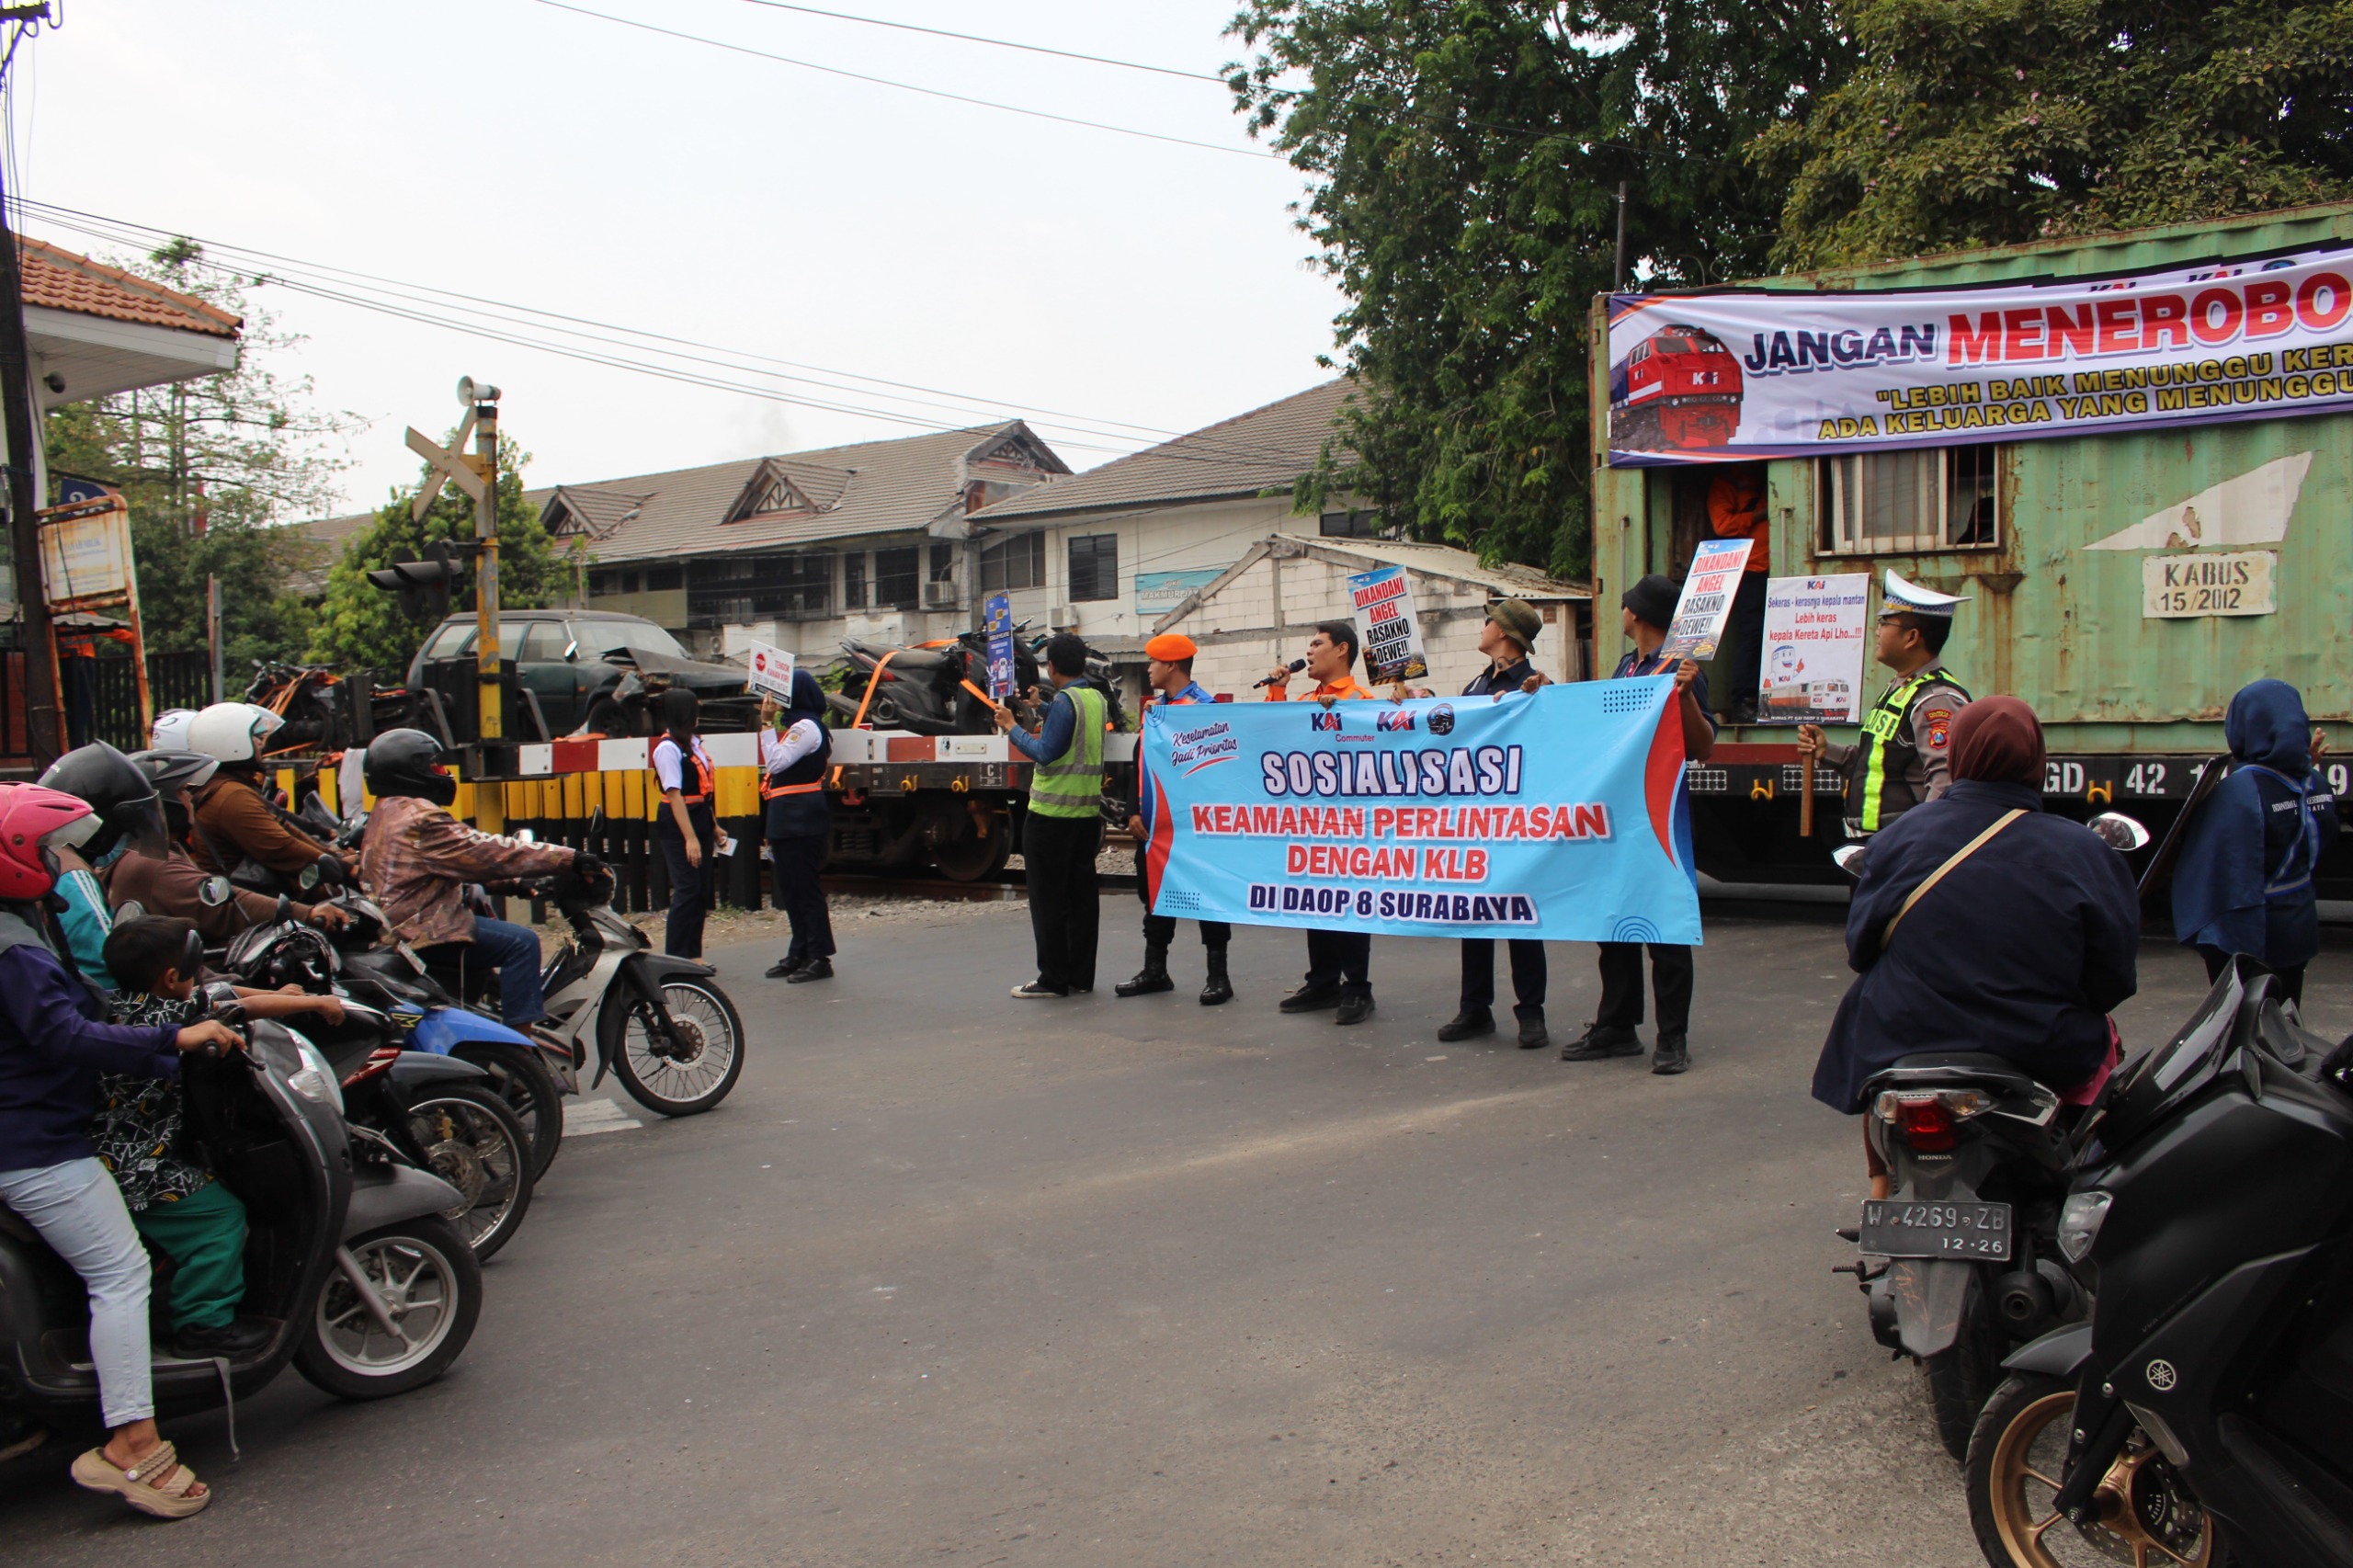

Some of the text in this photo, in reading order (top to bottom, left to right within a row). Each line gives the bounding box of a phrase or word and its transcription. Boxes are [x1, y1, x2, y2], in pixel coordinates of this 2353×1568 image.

[1744, 272, 2351, 370] JANGAN MENEROBO
[1989, 374, 2066, 402] BAIK
[2075, 352, 2272, 392] MENUNGGU
[1818, 369, 2353, 441] ADA KELUARGA YANG MENUNGGU
[1693, 551, 1745, 574] DIKANDANI
[2165, 561, 2249, 587] KABUS
[1354, 576, 1405, 608] DIKANDANI
[1696, 574, 1725, 594] ANGEL
[1807, 581, 1825, 590] KAI
[1370, 600, 1399, 624] ANGEL
[1682, 594, 1725, 615] RASAKNO
[1768, 597, 1790, 608] Sekeras
[1795, 597, 1821, 609] kerasnya
[1822, 596, 1841, 608] kepala
[1842, 595, 1865, 605] mantan
[1679, 616, 1713, 636] DEWE!!
[1795, 612, 1836, 624] Lebih keras
[1367, 618, 1410, 646] RASAKNO
[1769, 629, 1792, 643] kepala
[1795, 629, 1819, 641] Kereta
[1821, 628, 1833, 642] Api
[1376, 640, 1409, 664] DEWE!!
[1311, 712, 1343, 732] KAI
[1377, 710, 1416, 732] KAI
[1172, 722, 1230, 747] Keselamatan
[1336, 733, 1375, 743] Commuter
[1171, 738, 1238, 767] Jadi Prioritas
[1262, 745, 1521, 797] SOSIALISASI
[2126, 763, 2165, 794] 42
[1191, 805, 1607, 837] KEAMANAN PERLINTASAN
[1287, 846, 1486, 880] DENGAN KLB
[1250, 886, 1533, 921] DI DAOP 8 SURABAYA
[1868, 1204, 1882, 1227] W
[1903, 1206, 1957, 1229] 4269
